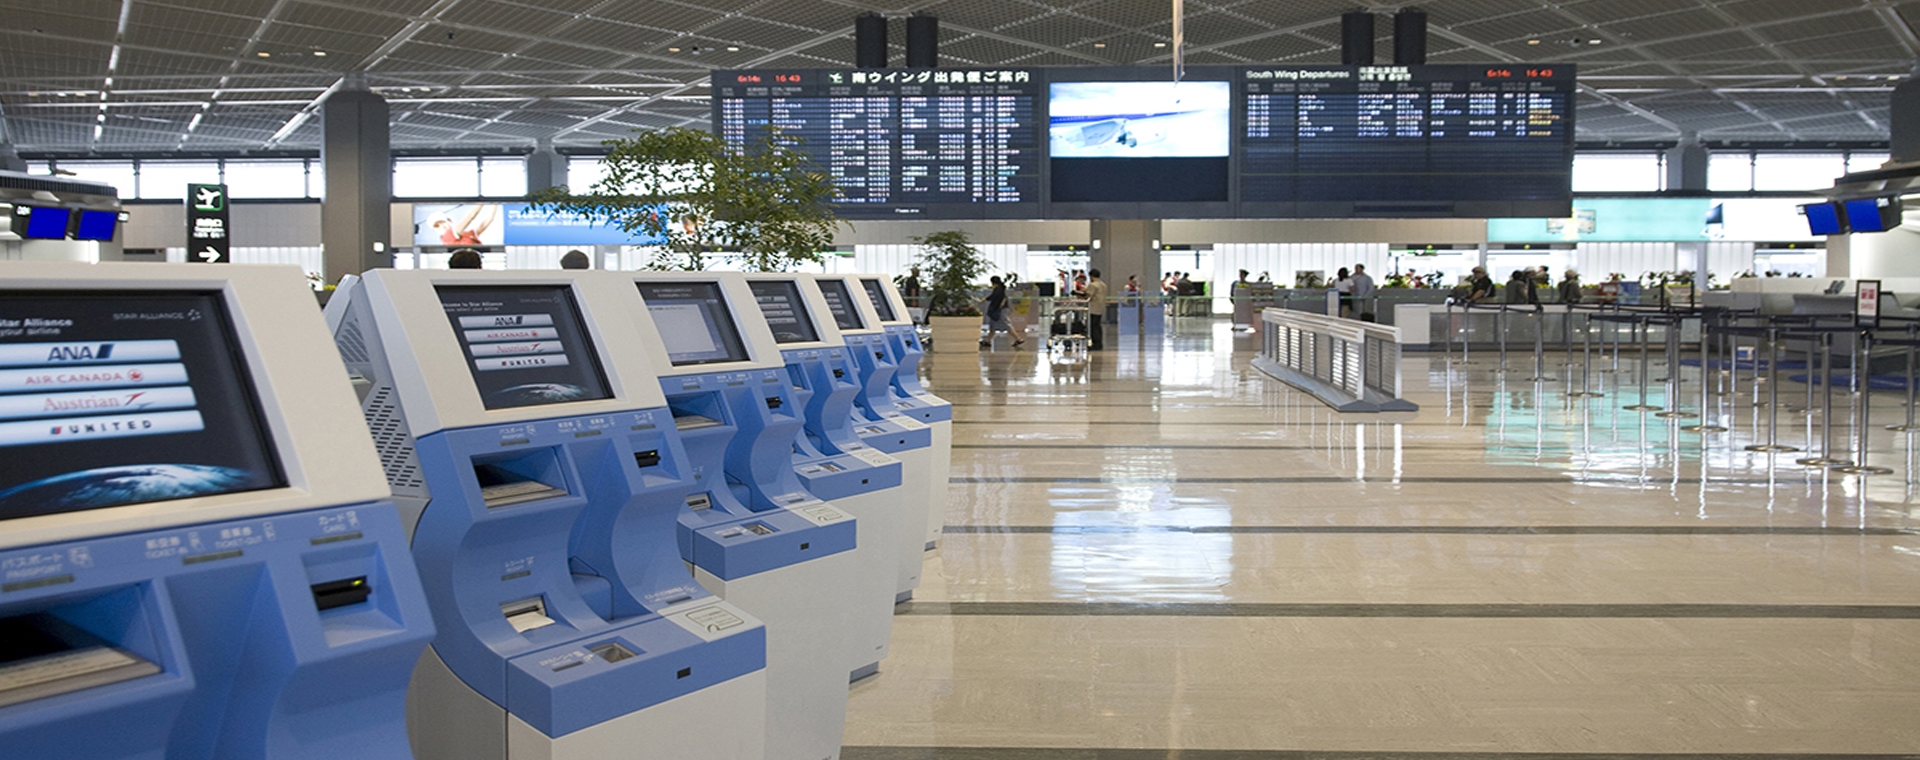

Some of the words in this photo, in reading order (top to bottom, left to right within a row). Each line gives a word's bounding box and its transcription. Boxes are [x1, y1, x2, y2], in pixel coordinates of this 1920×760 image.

[852, 71, 1029, 83] 南ウイング出発便ご案内
[1246, 70, 1273, 78] South
[1274, 70, 1298, 80] Wing
[1300, 70, 1350, 79] Departures
[24, 318, 73, 327] Alliance
[495, 317, 513, 326] ANA
[48, 346, 93, 361] ANA
[509, 358, 547, 367] UNITED
[25, 376, 53, 385] AIR
[56, 372, 124, 384] CANADA
[43, 395, 120, 412] Austrian
[69, 419, 152, 434] UNITED
